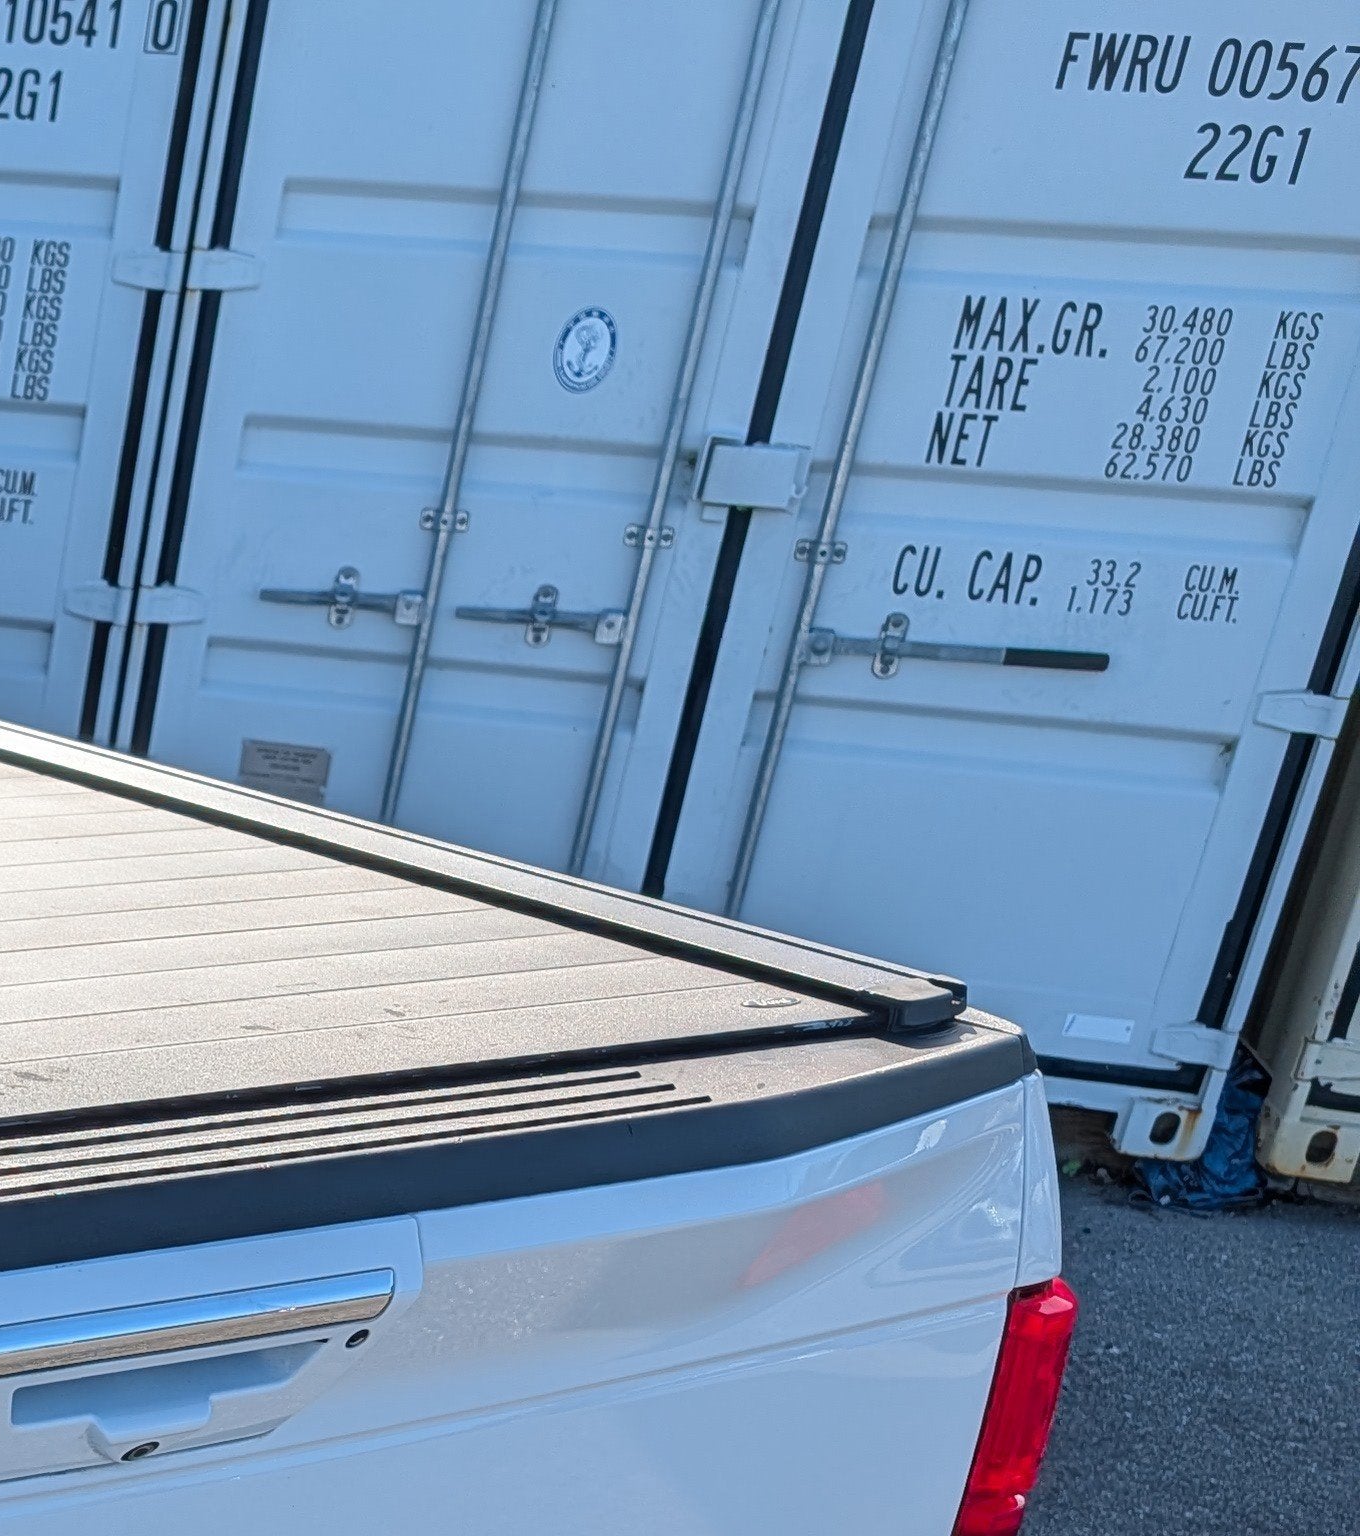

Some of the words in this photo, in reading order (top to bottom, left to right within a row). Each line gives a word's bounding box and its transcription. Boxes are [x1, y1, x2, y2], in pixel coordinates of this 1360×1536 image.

[151, 0, 178, 50] 0
[1055, 31, 1192, 94] FWRU
[1207, 37, 1360, 104] 00567
[1183, 122, 1312, 185] 22G1
[30, 239, 72, 268] KGS
[27, 266, 67, 295] LBS
[22, 294, 63, 322] KGS
[18, 320, 58, 349] LBS
[953, 295, 1108, 358] MAX.GR.
[1142, 305, 1233, 336] 30.480
[1274, 310, 1324, 341] KGS
[14, 347, 55, 375] KGS
[1135, 335, 1225, 366] 67.200
[1265, 341, 1315, 371] LBS
[10, 373, 50, 401] LBS
[944, 354, 1038, 412] TARE
[1142, 366, 1216, 395] 2.100
[1256, 371, 1307, 401] KGS
[1136, 395, 1209, 425] 4.630
[1249, 401, 1298, 431] LBS
[925, 411, 999, 468] NET
[1111, 423, 1201, 453] 28.380
[1241, 429, 1290, 459] KGS
[1104, 452, 1193, 482] 62.570
[1232, 458, 1281, 488] LBS
[892, 544, 945, 599] CU.
[968, 550, 1043, 606] CAP.
[1086, 558, 1142, 588] 33.2
[1184, 564, 1240, 595] CU.M.
[1066, 585, 1134, 617] 1.173
[1177, 593, 1240, 625] CU.FT.
